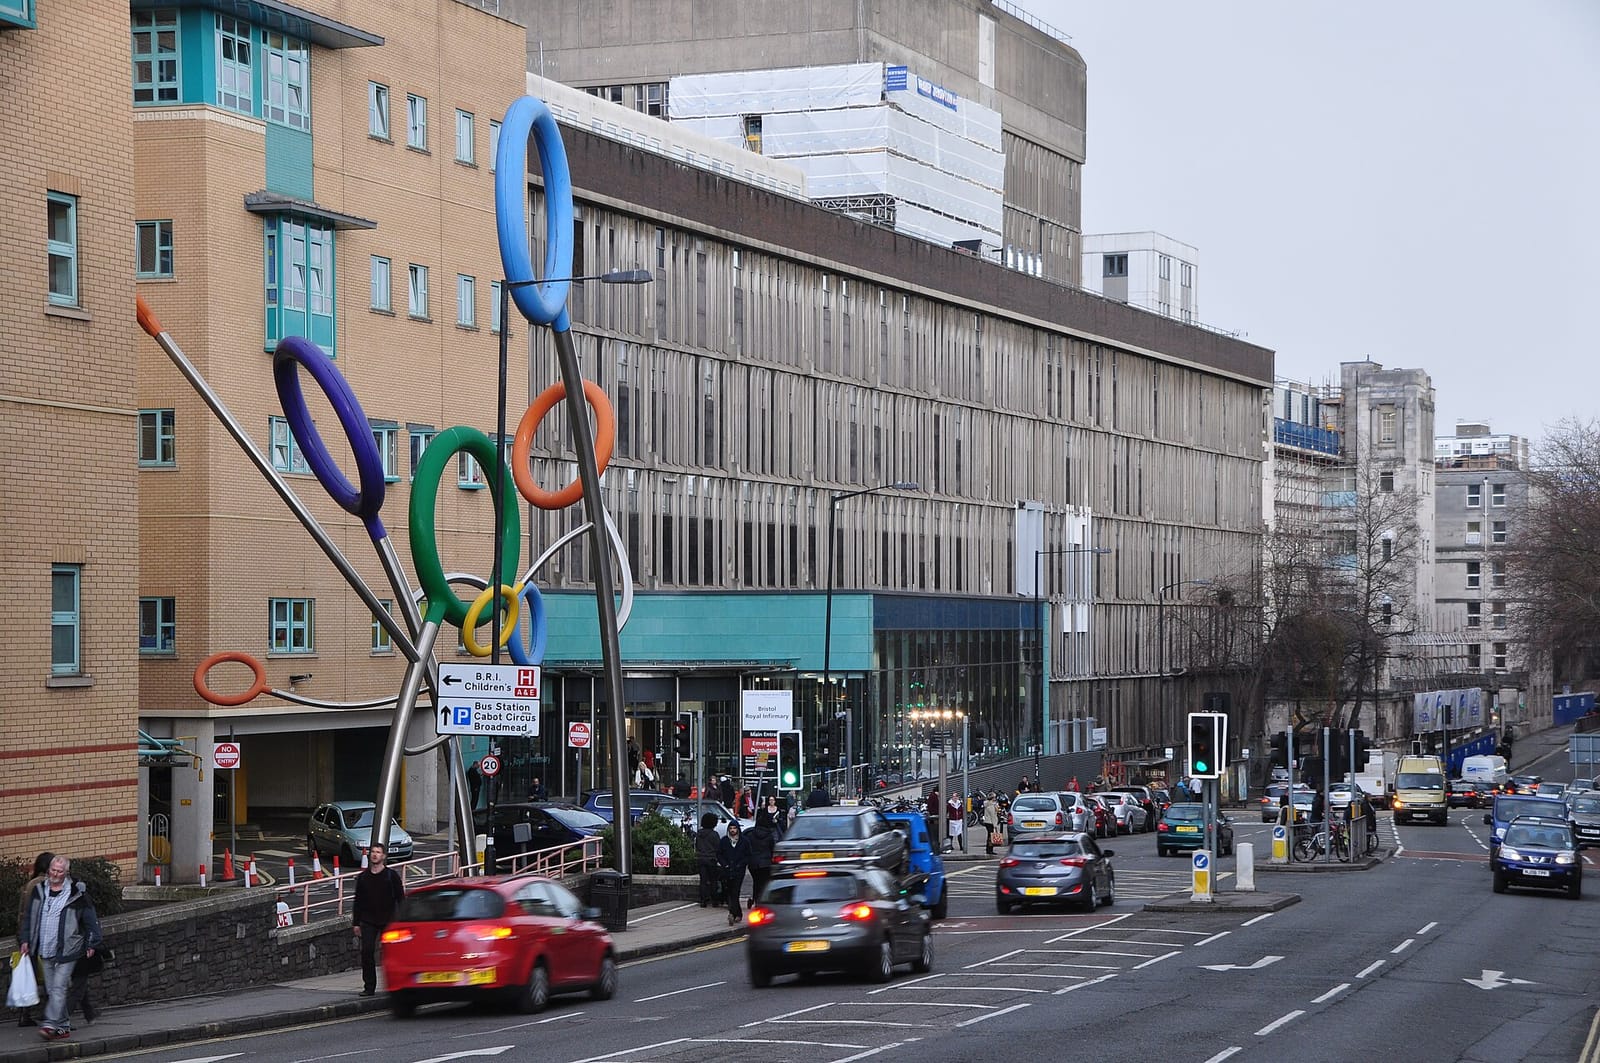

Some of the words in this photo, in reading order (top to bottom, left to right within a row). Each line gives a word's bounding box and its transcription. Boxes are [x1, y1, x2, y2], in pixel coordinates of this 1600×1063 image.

[475, 672, 502, 681] B.R.I.
[520, 670, 533, 686] H
[464, 682, 512, 692] Children's
[474, 702, 492, 711] Bus
[495, 702, 530, 711] Station
[457, 708, 469, 724] P
[474, 712, 503, 721] Cabot
[505, 713, 537, 722] Circus
[474, 722, 528, 732] Broadmead
[752, 740, 777, 748] Emergen
[483, 760, 498, 770] 20
